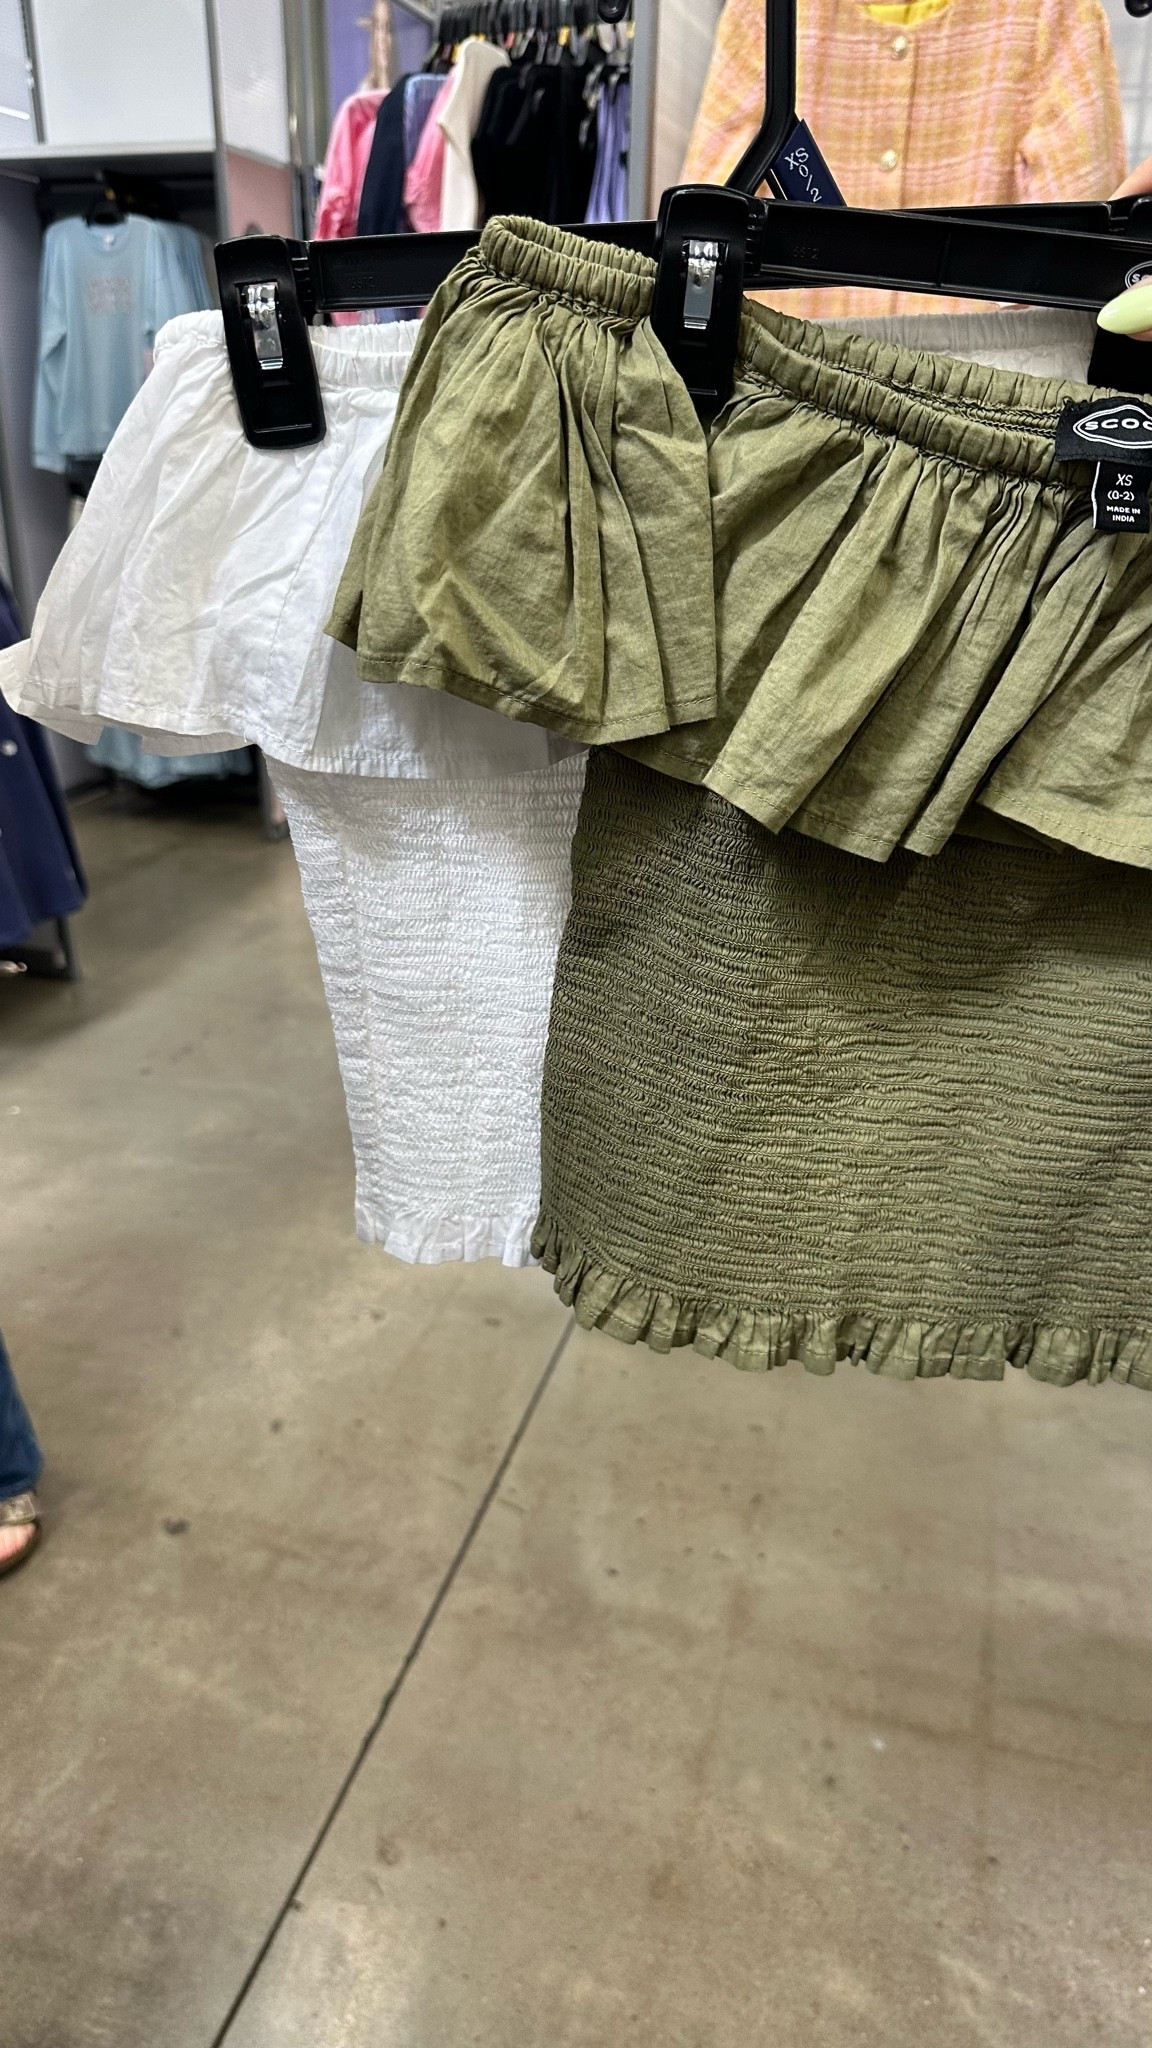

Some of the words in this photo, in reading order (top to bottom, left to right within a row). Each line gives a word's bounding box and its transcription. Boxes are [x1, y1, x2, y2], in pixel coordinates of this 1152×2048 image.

[785, 147, 809, 170] XS
[798, 164, 822, 202] 0/2
[1116, 473, 1133, 486] XS
[1107, 490, 1135, 502] (0-2)
[1106, 505, 1130, 514] MADE
[1132, 507, 1140, 515] IN
[1112, 514, 1135, 523] INDIA
